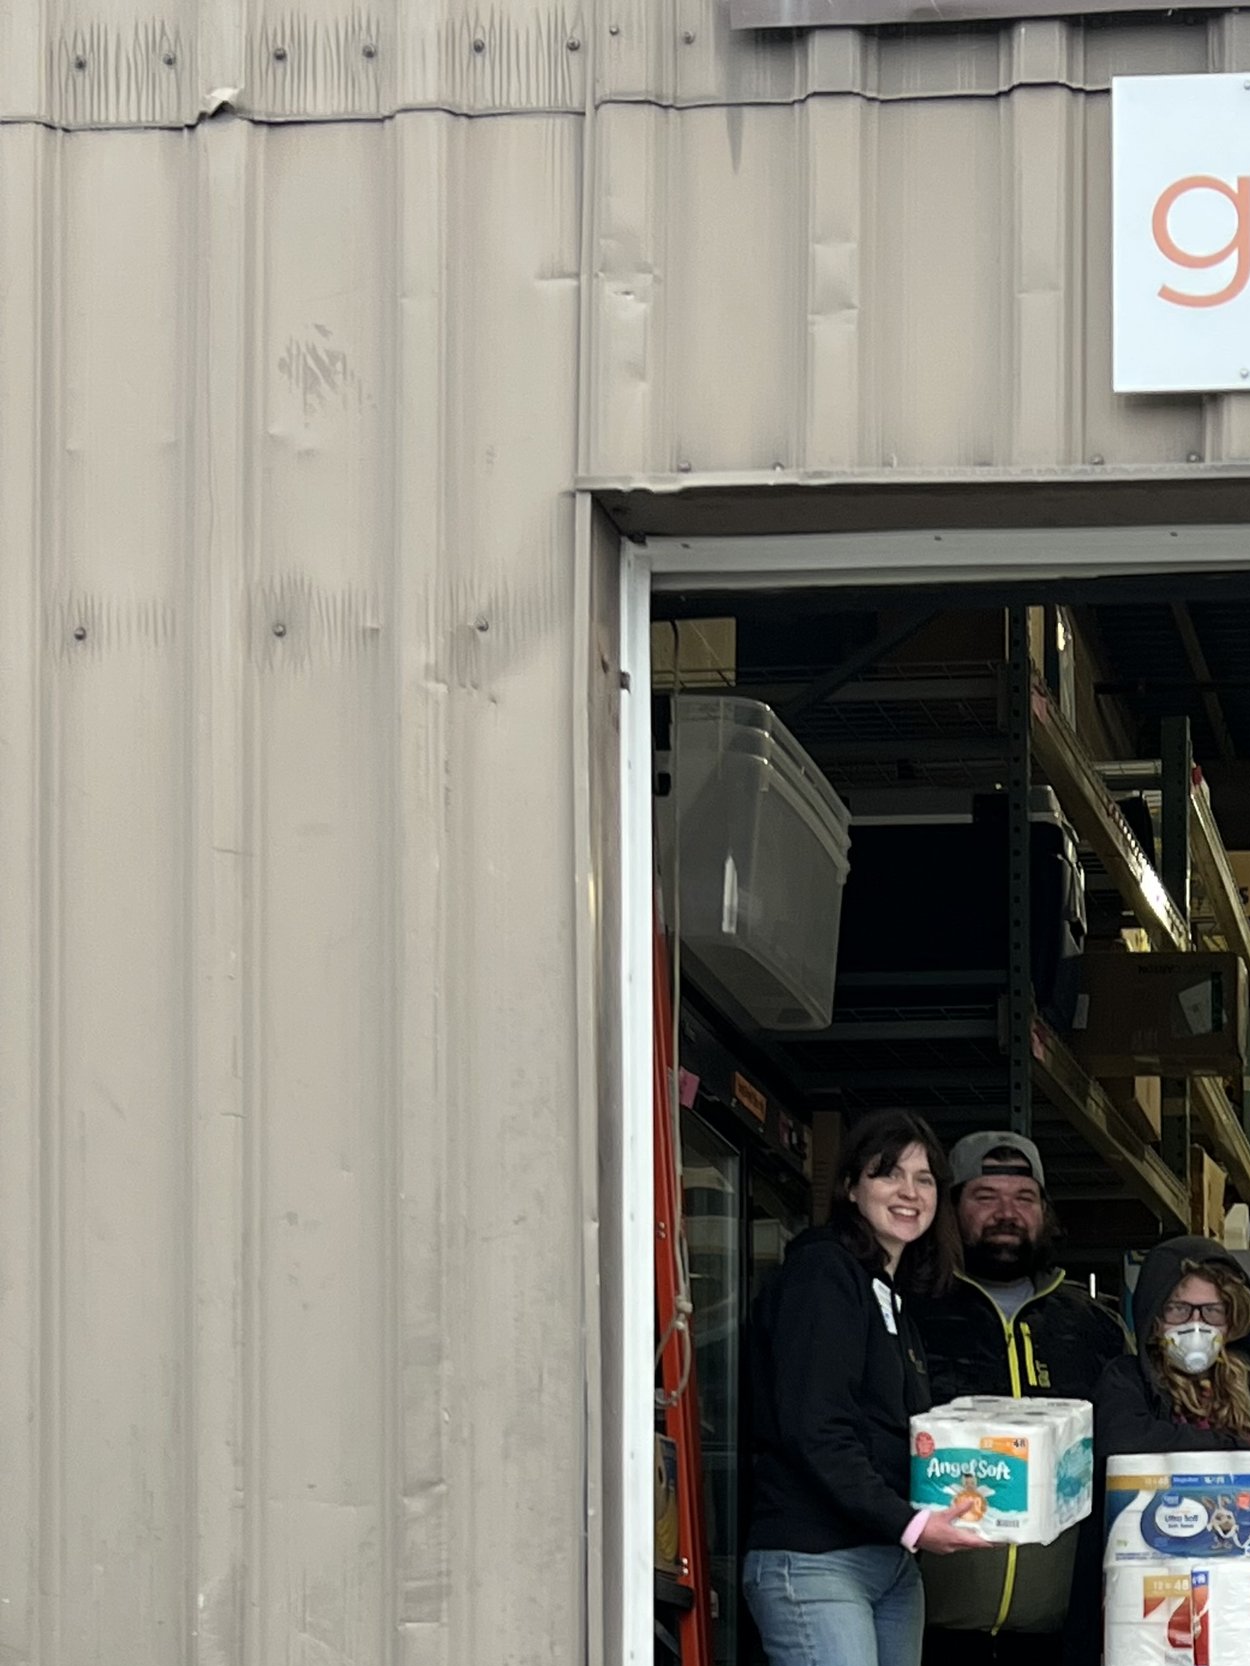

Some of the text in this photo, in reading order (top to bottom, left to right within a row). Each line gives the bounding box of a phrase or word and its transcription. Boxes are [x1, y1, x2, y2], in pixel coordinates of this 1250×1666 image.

[927, 1458, 1012, 1481] Angel Soft
[1153, 1578, 1189, 1592] 12 48
